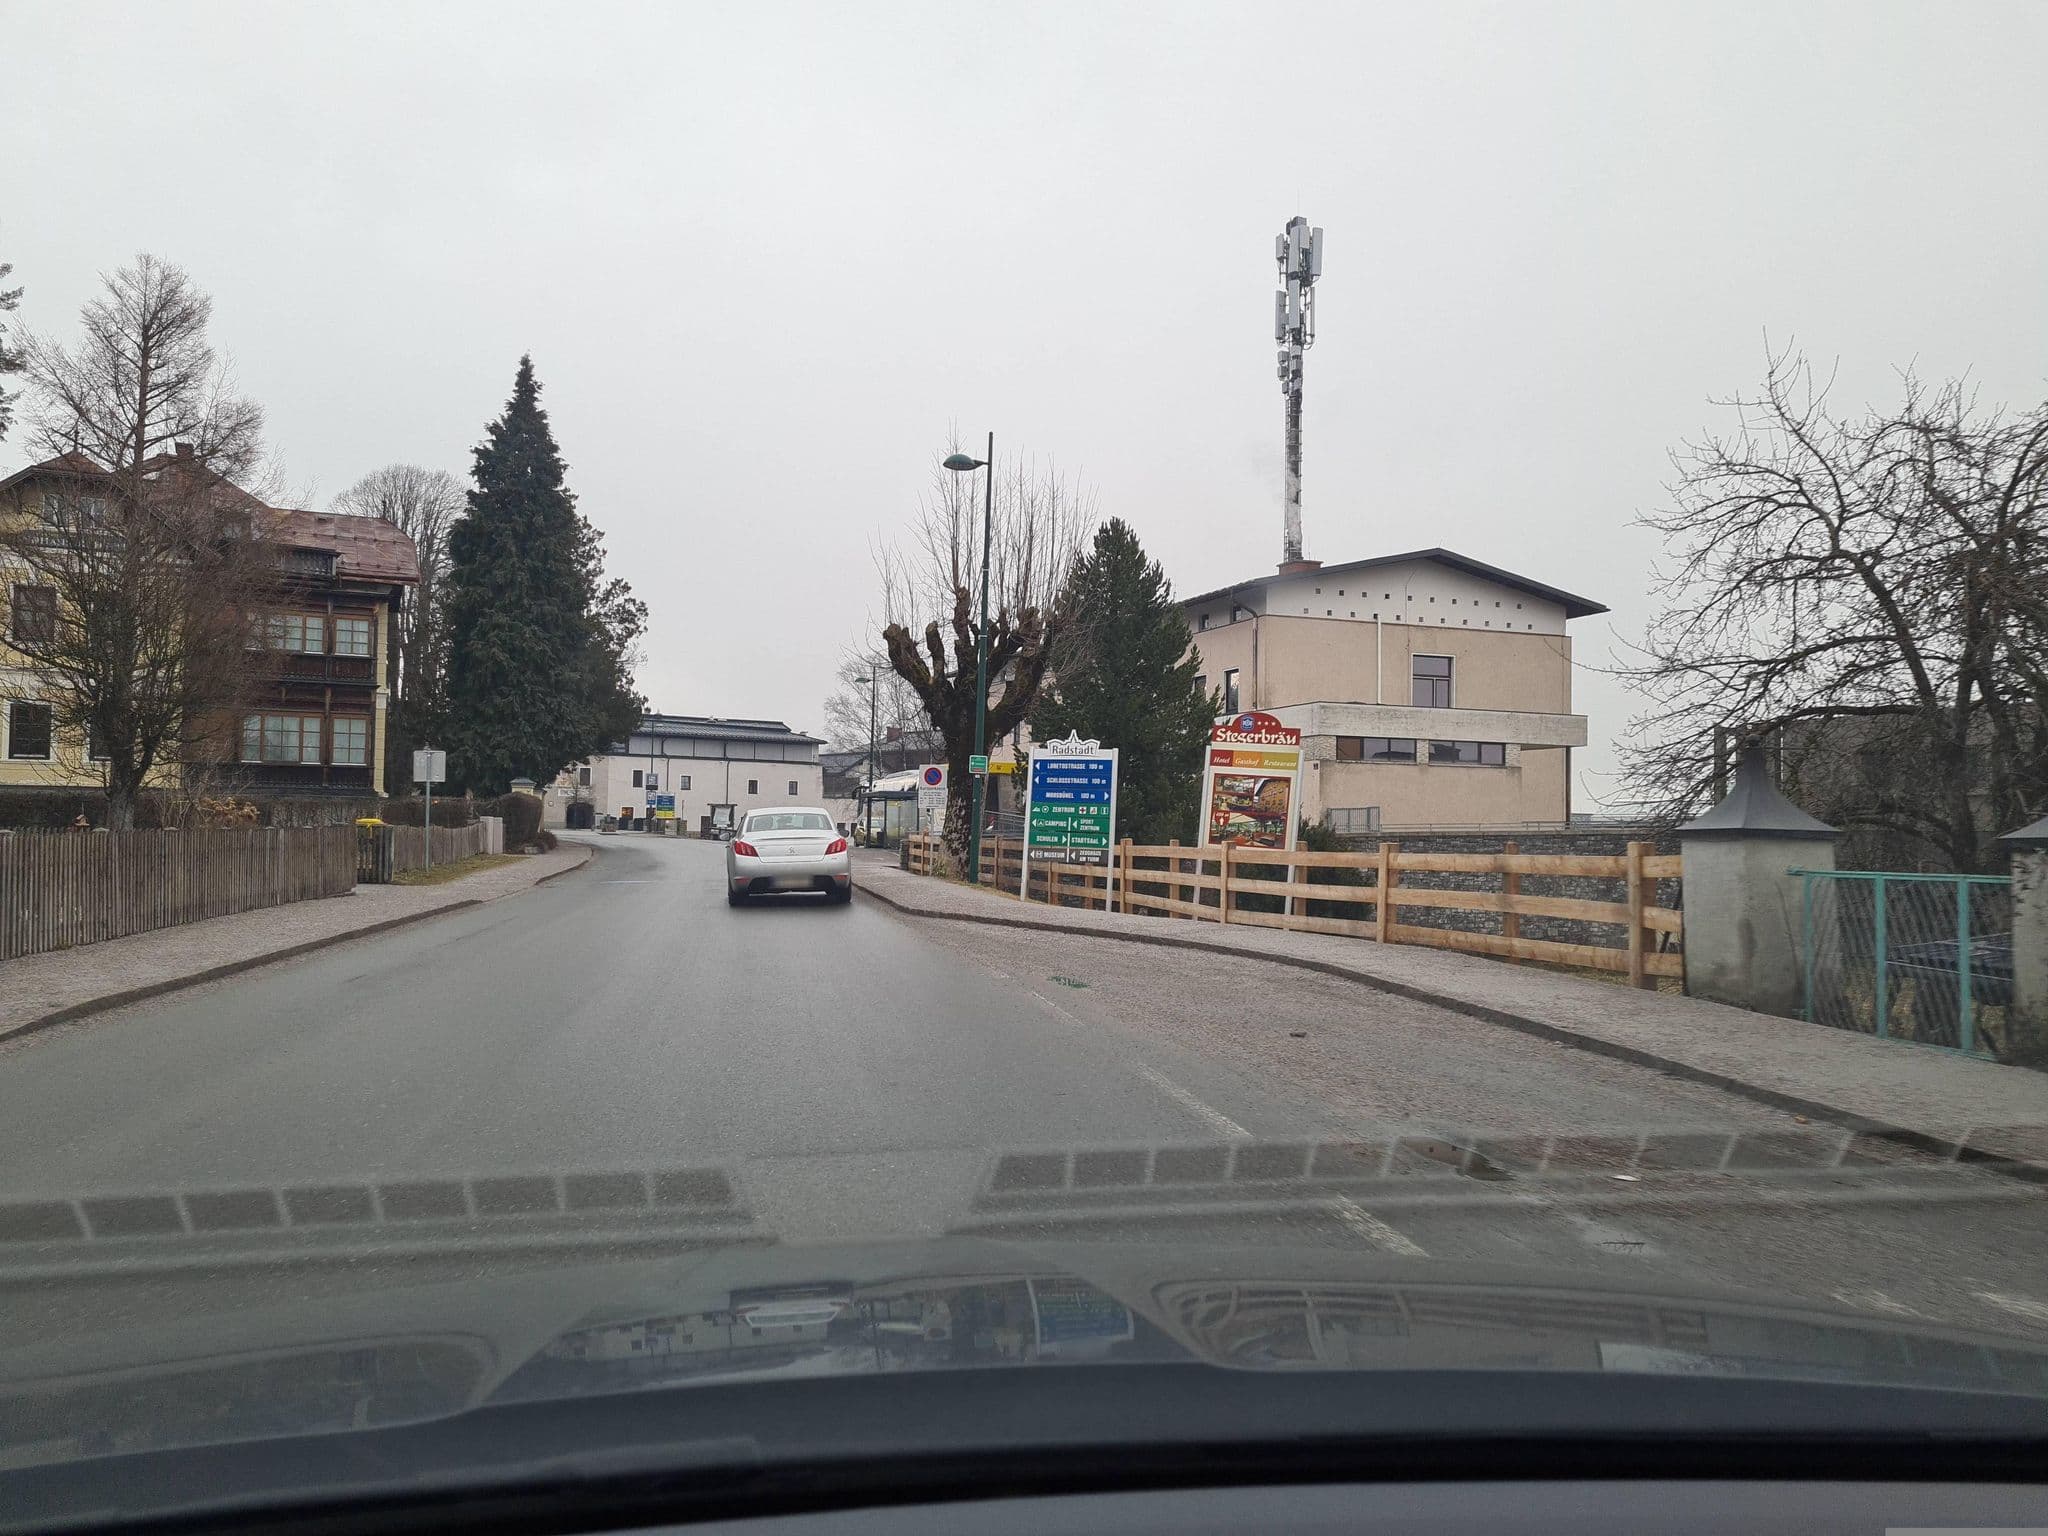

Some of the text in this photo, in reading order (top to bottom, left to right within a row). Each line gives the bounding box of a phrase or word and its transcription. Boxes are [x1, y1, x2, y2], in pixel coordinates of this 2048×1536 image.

[1215, 728, 1297, 745] Stegerbräu
[1052, 745, 1094, 755] Radstadt
[1213, 756, 1231, 764] Hotel
[1235, 758, 1259, 766] Gasthof
[1263, 759, 1297, 768] Restaurant
[1036, 835, 1058, 843] SCHULEN
